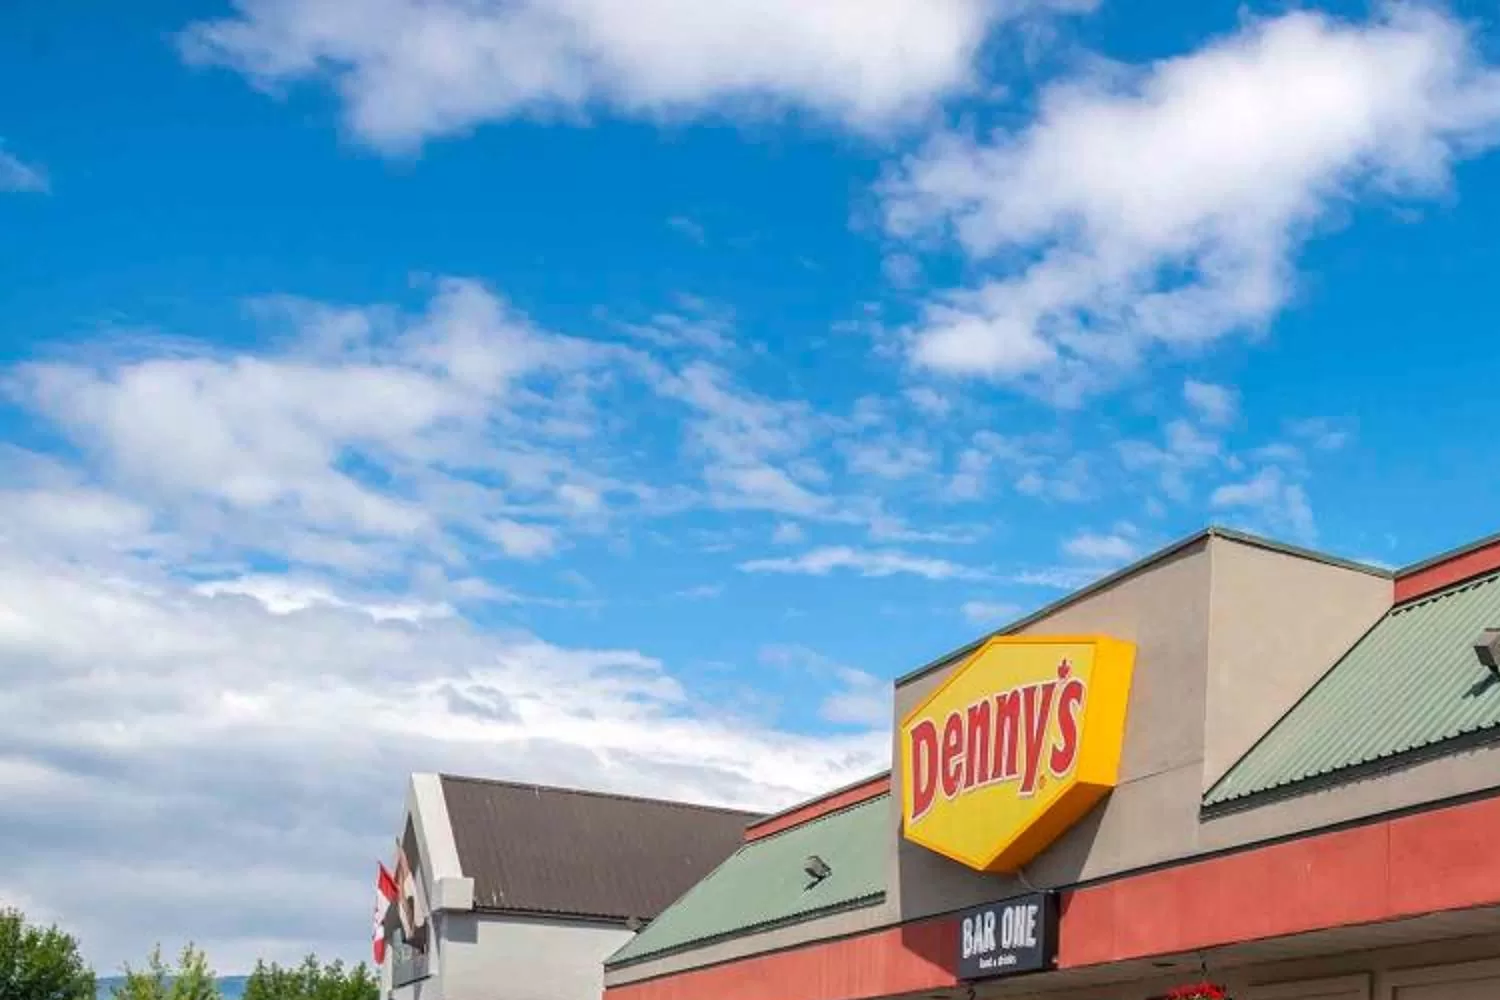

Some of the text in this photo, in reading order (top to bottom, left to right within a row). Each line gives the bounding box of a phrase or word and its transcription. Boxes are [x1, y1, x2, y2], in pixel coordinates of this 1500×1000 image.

[910, 659, 1085, 820] Denny's
[963, 905, 1039, 959] BAR ONE
